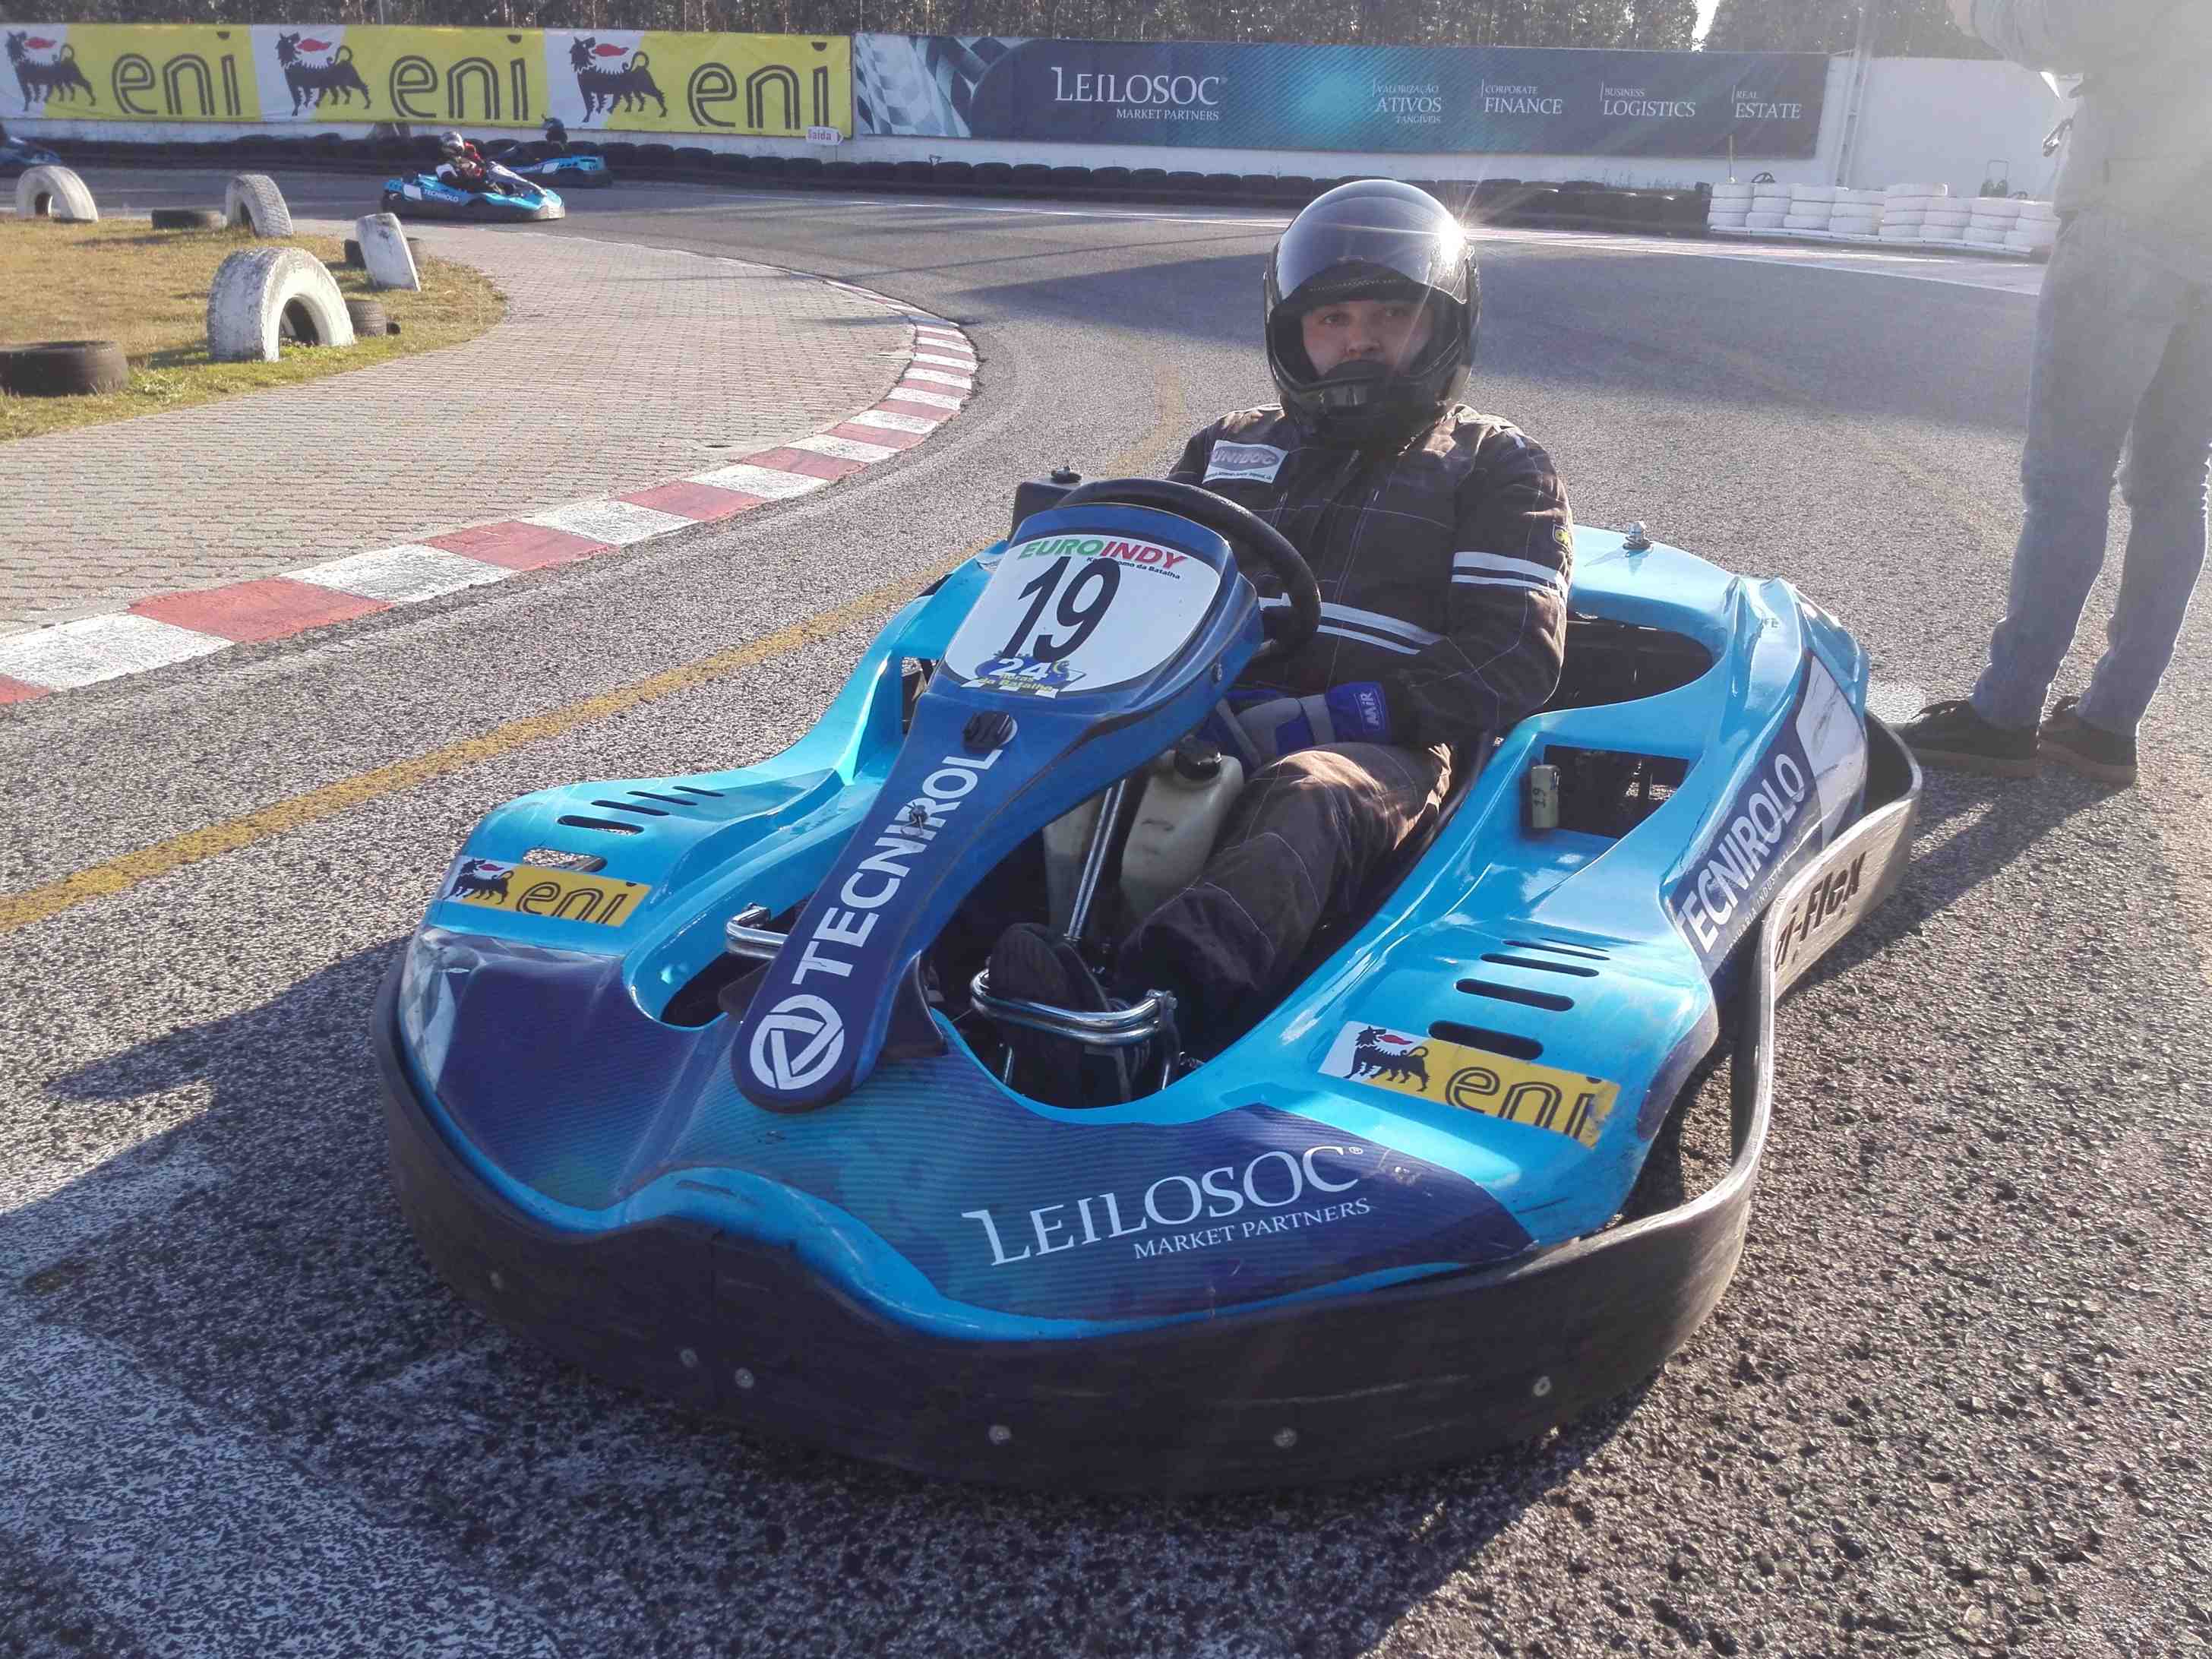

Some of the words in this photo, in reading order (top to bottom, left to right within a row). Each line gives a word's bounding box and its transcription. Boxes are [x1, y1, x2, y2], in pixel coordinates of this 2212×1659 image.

[112, 31, 242, 116] eni
[389, 34, 529, 121] eni
[687, 42, 830, 130] eni
[1051, 67, 1220, 105] LEILOSOC
[1485, 85, 1538, 94] CORPORATE
[1375, 96, 1442, 112] ATIVOS
[1484, 98, 1563, 115] FINANCE
[1603, 100, 1696, 117] LOGISTICS
[1604, 87, 1645, 97] BUSINESS
[1736, 90, 1759, 99] REAL
[1116, 109, 1164, 120] MARKET
[1164, 110, 1219, 121] PARTNERS
[1735, 103, 1803, 119] ESTATE
[1019, 539, 1188, 569] EUROINDY
[1001, 556, 1121, 663] 19
[989, 658, 1052, 681] 24
[792, 718, 1018, 985] TECNIROL
[516, 880, 636, 924] eni
[1445, 1066, 1602, 1139] eni
[962, 1146, 1359, 1266] LEILOSOC
[1133, 1224, 1234, 1259] MARKET
[1243, 1197, 1371, 1239] PARTNERS
